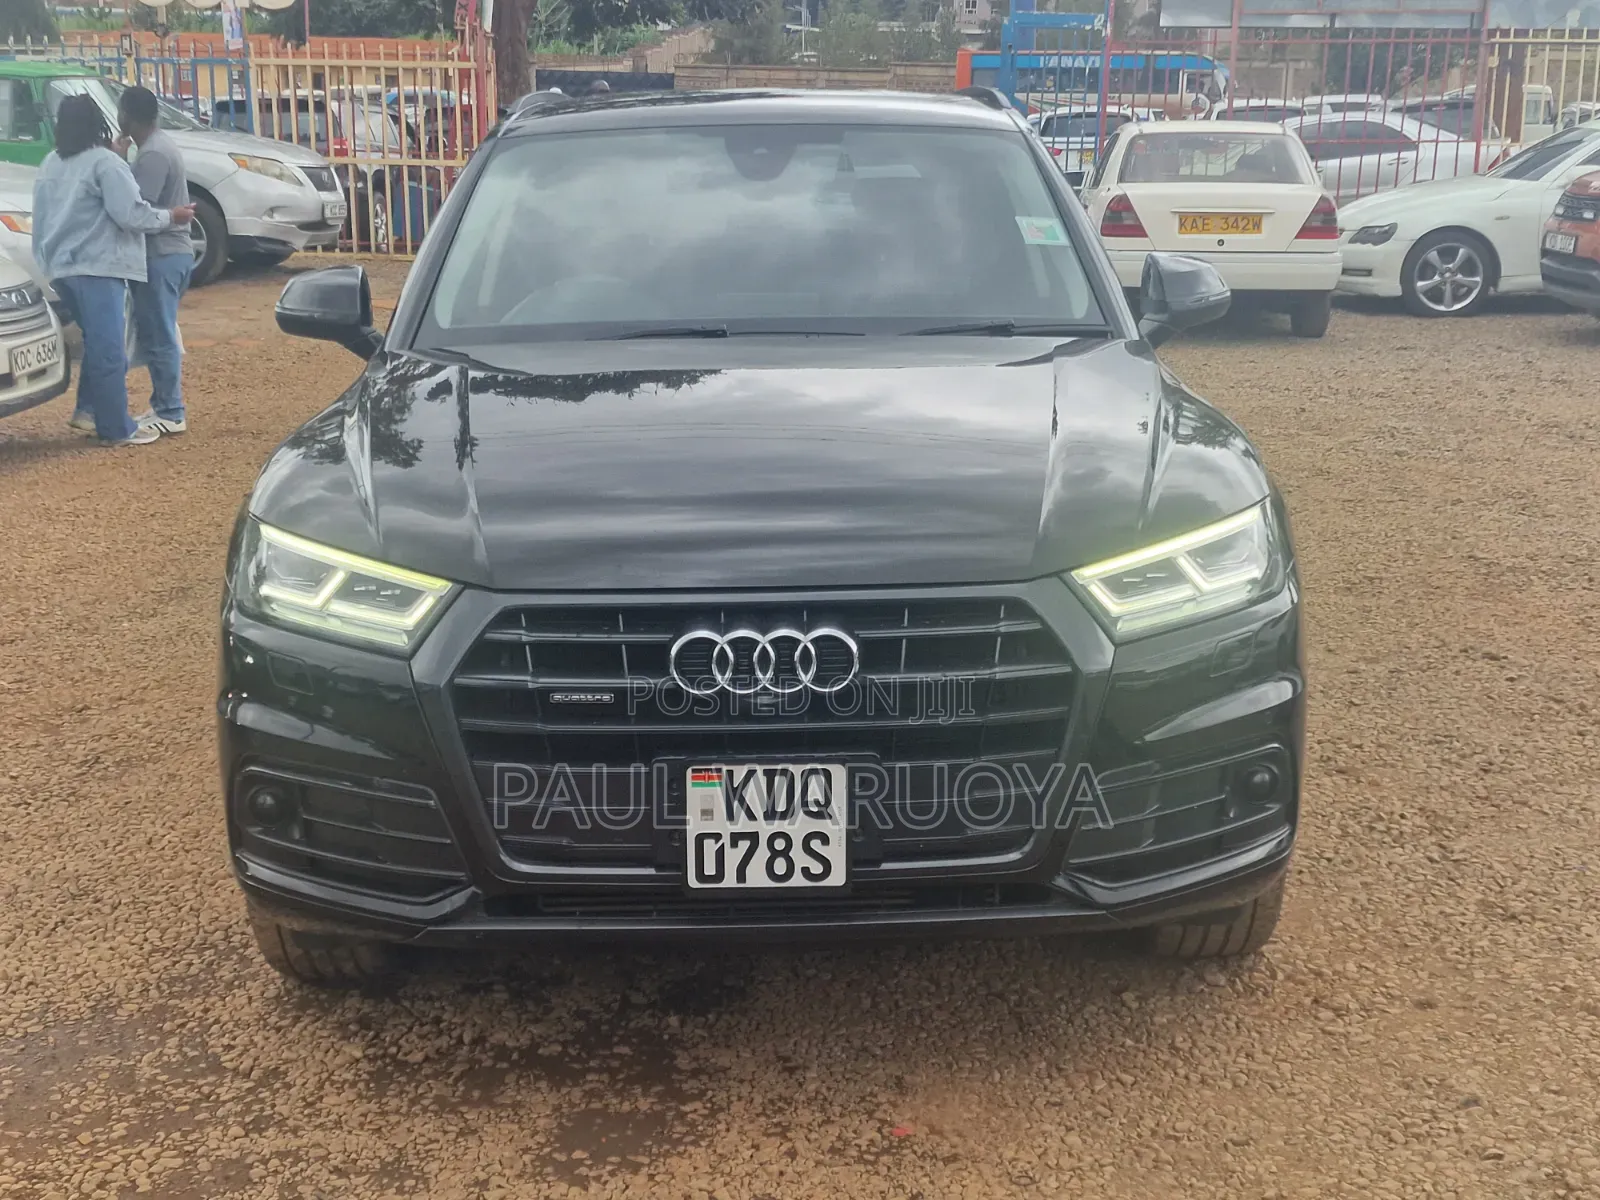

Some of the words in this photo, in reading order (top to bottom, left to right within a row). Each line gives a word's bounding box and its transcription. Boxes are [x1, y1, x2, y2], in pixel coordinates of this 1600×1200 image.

[1179, 216, 1211, 231] KAE
[1220, 216, 1260, 231] 342W
[13, 347, 32, 373] KDC
[551, 693, 613, 703] quattro
[725, 767, 833, 822] KDQ
[694, 830, 832, 884] 078S
